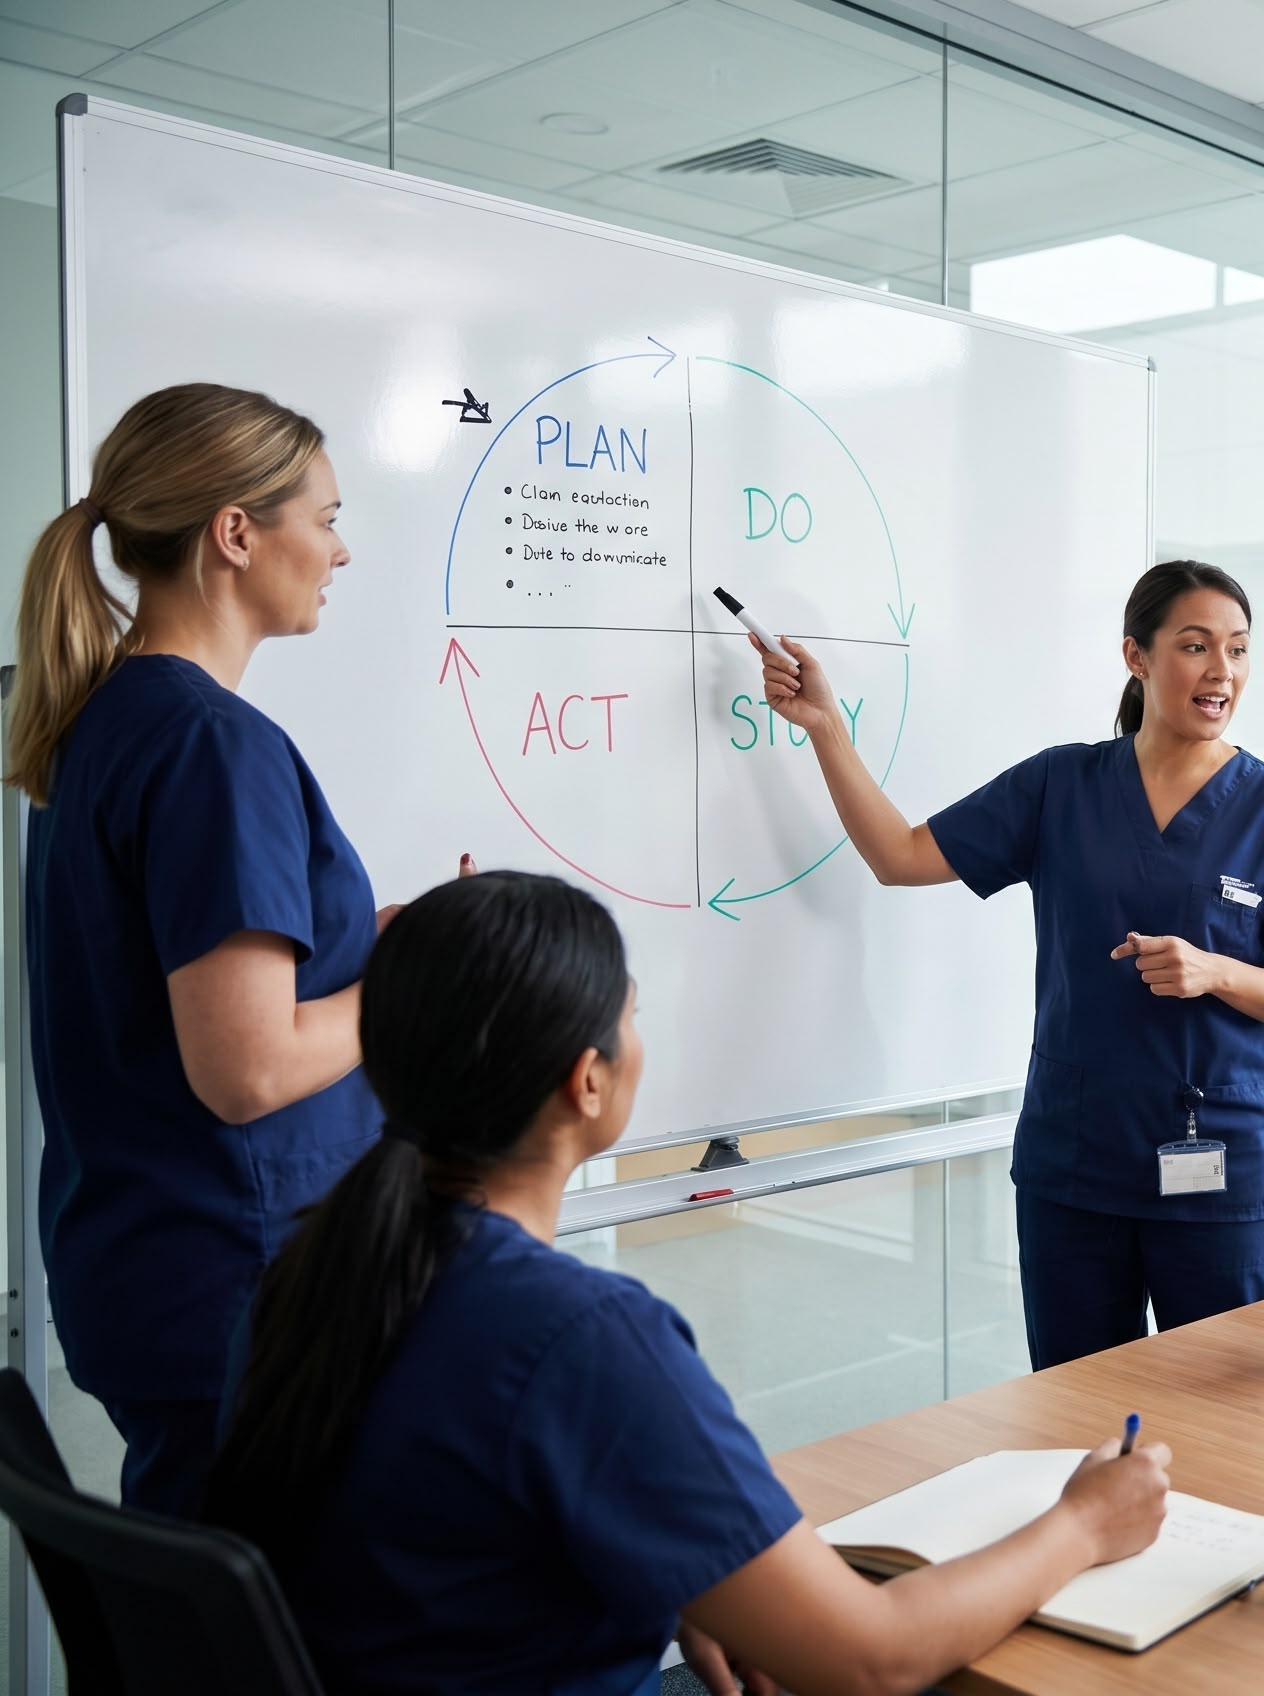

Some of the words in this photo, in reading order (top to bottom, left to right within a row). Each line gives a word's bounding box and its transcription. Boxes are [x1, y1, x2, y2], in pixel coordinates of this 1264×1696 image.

[535, 415, 647, 474] PLAN
[575, 518, 600, 534] the
[743, 487, 813, 544] DO
[560, 547, 575, 562] to
[523, 692, 629, 757] ACT
